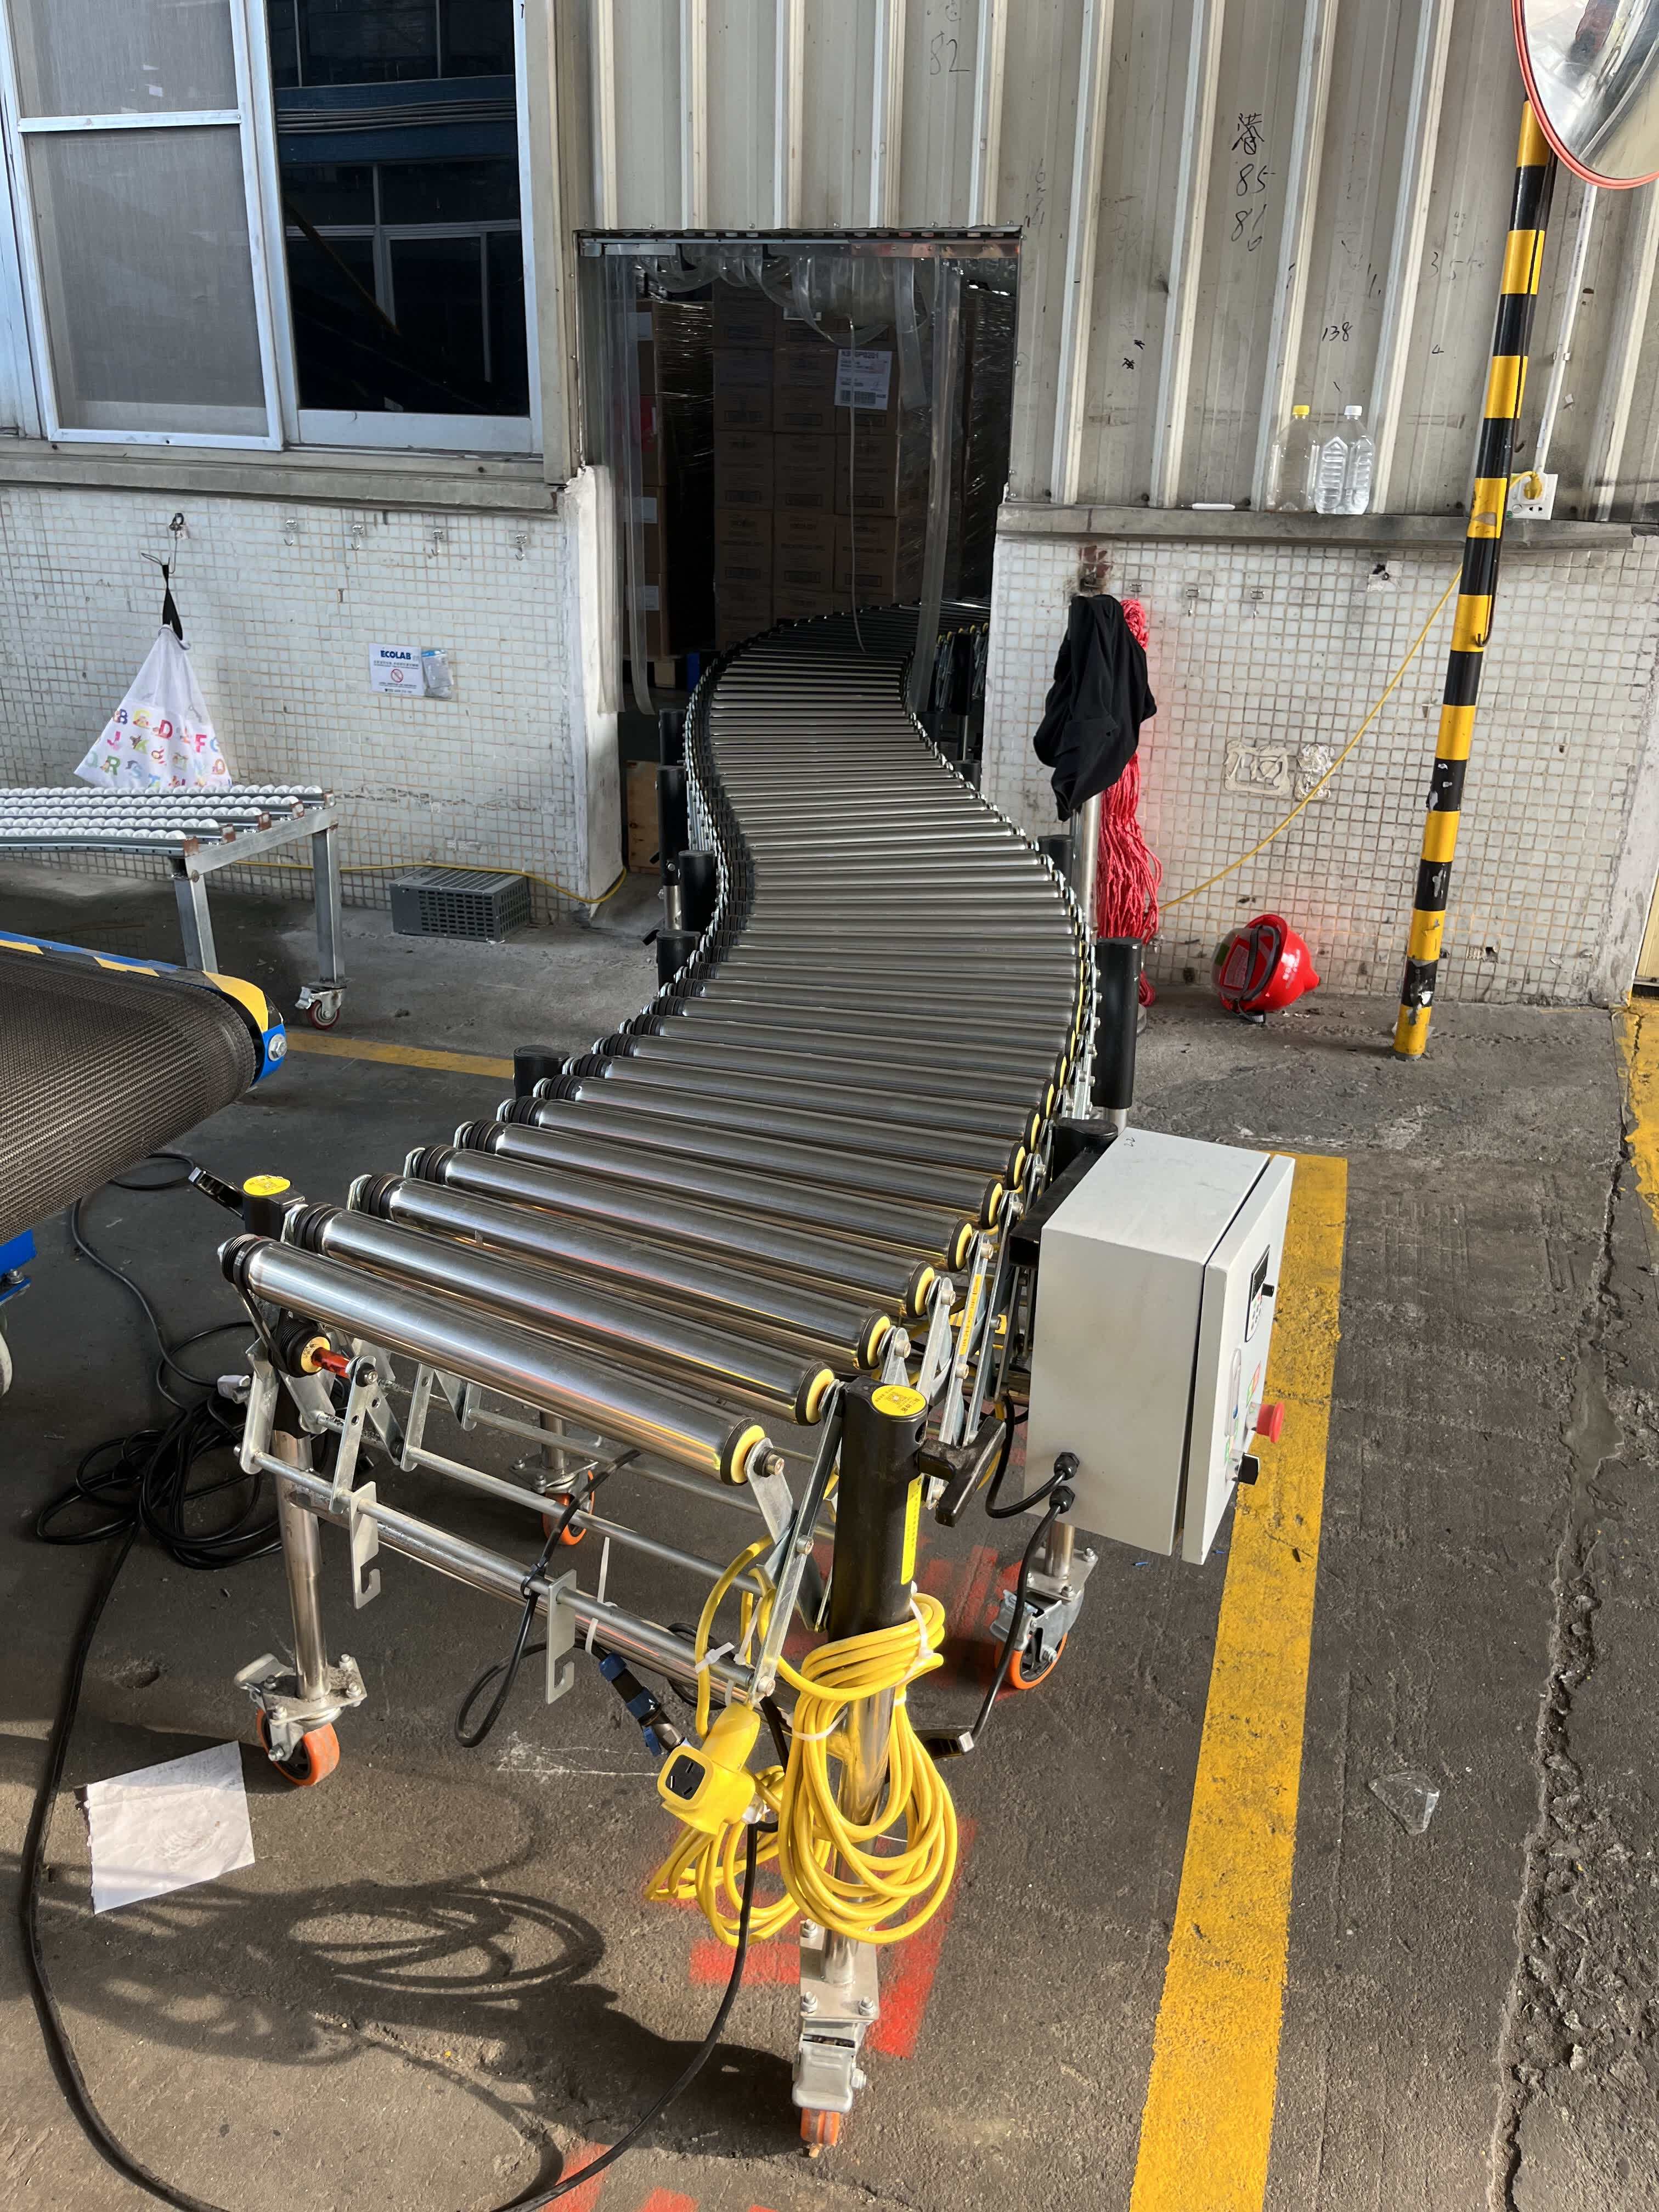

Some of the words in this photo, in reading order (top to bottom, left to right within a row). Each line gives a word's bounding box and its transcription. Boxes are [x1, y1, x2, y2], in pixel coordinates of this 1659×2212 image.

[1236, 163, 1276, 196] 85
[1322, 321, 1353, 342] 138
[380, 650, 411, 660] ECOLAB
[158, 719, 173, 739] D
[195, 734, 207, 753] F
[104, 755, 121, 776] R
